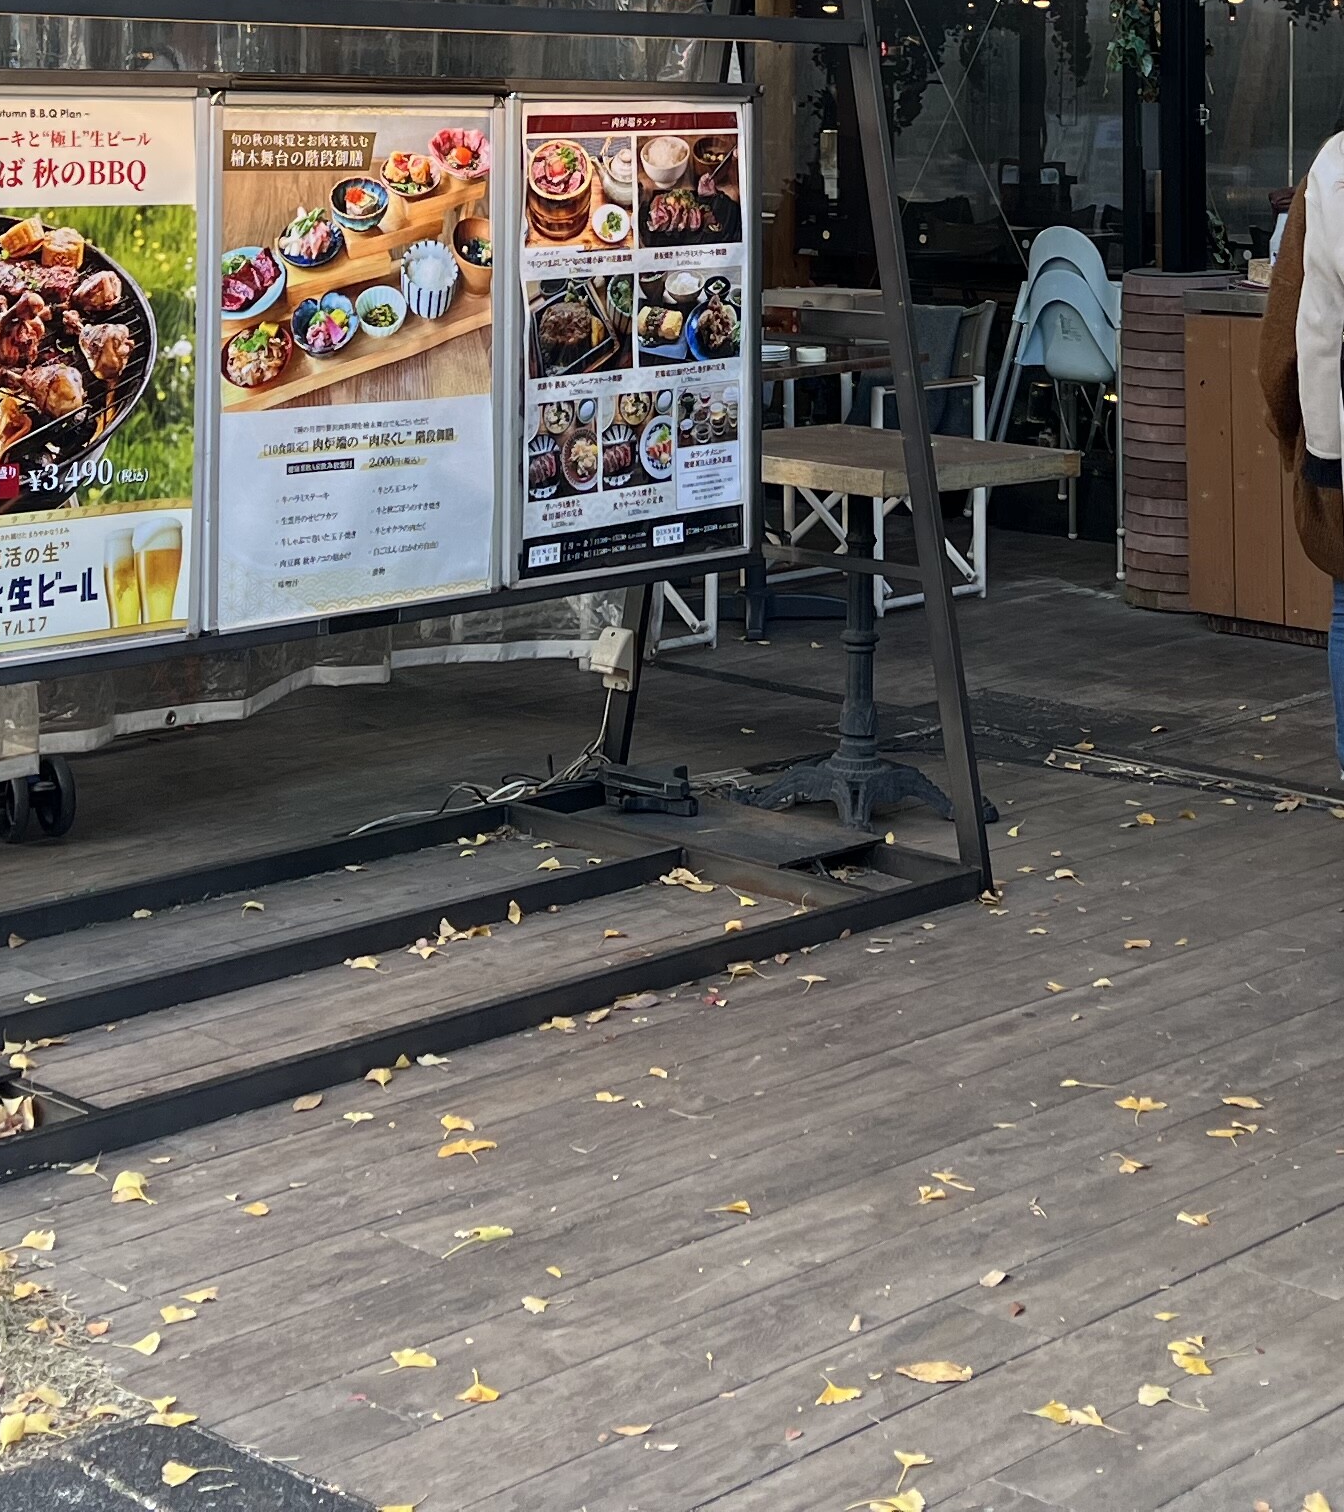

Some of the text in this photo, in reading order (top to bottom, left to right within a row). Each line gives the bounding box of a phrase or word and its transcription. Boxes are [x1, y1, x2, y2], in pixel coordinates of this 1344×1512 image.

[60, 109, 82, 119] Plan
[230, 132, 369, 148] 旬の秋の味覚とお肉を楽しむ
[230, 148, 364, 168] 檜木舞台の階段御膳
[32, 157, 148, 192] 秋のBBQ
[28, 458, 113, 492] ¥3,490
[2, 616, 47, 636] マルエフ
